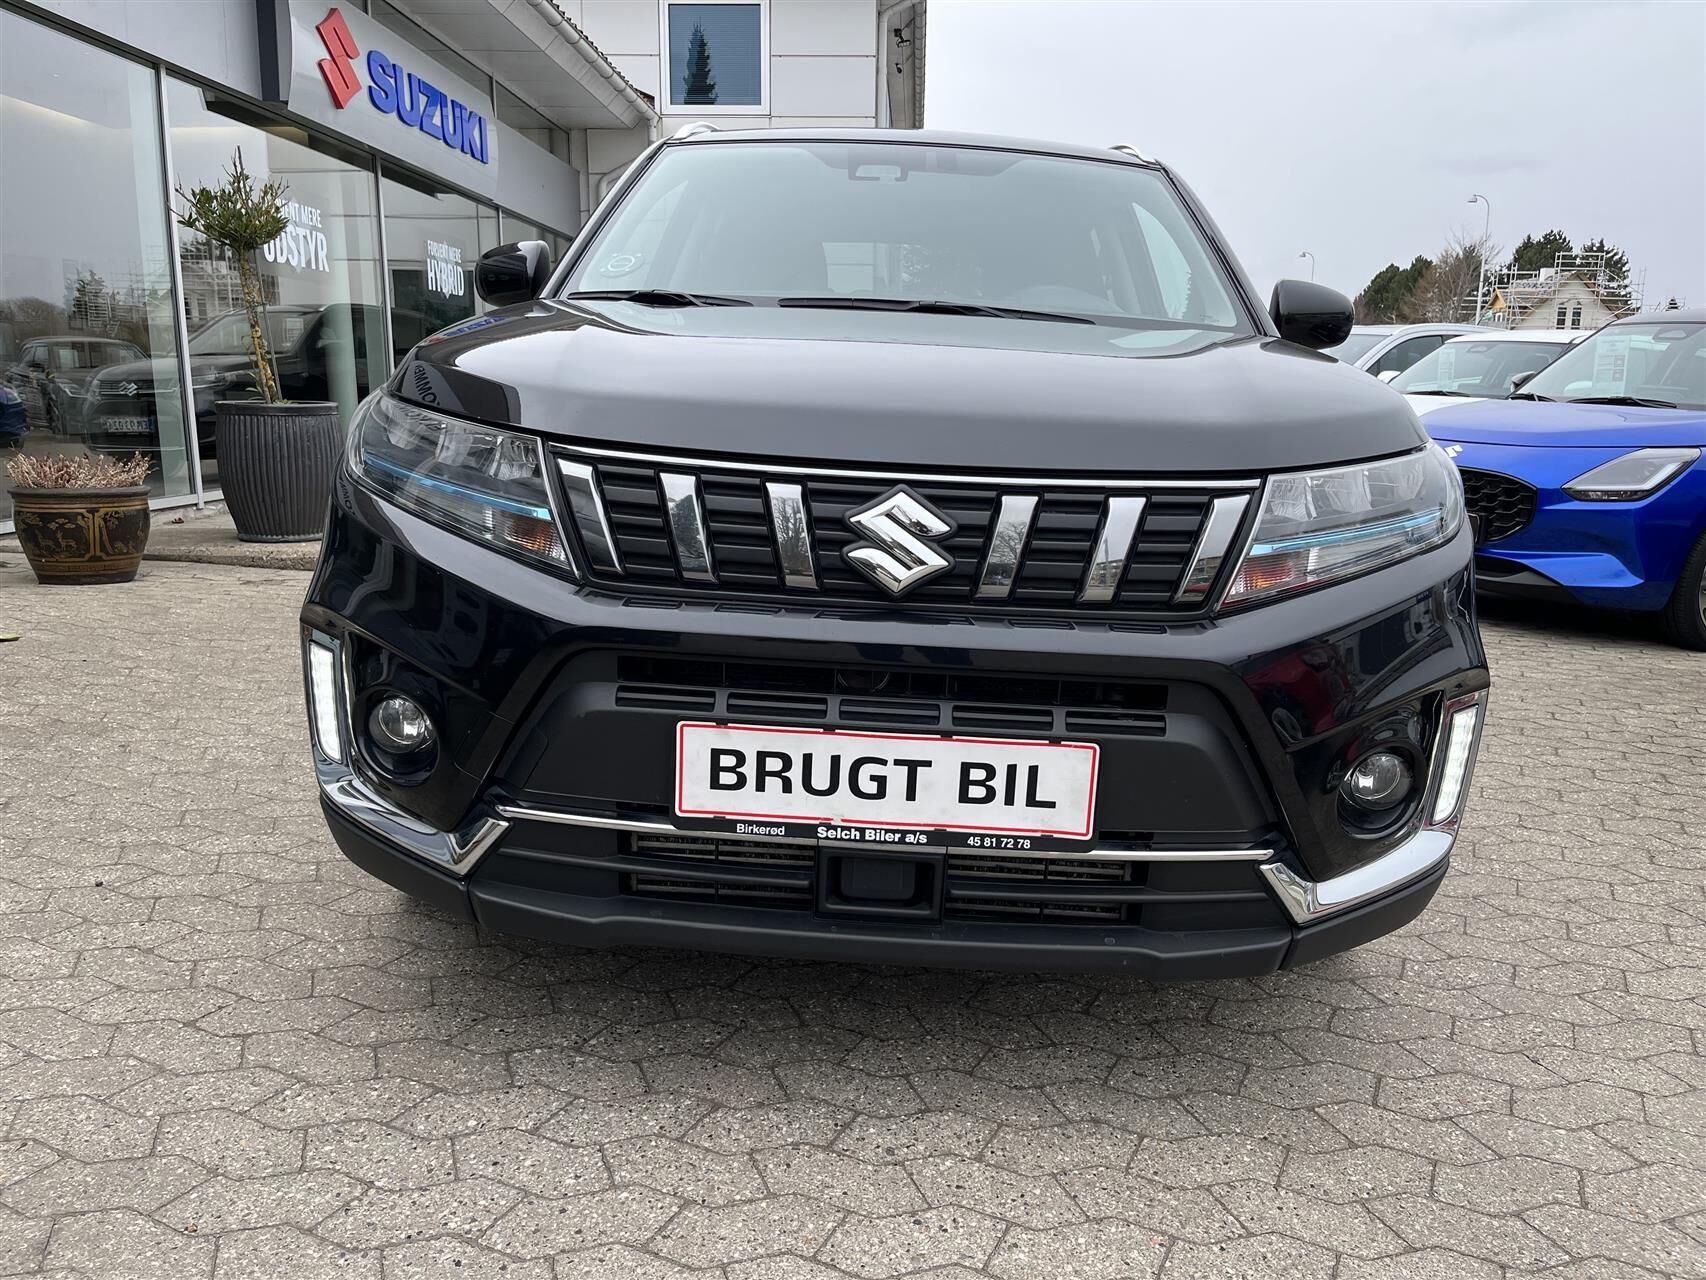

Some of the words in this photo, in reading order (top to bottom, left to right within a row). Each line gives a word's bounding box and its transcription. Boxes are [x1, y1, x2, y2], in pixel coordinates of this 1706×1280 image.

[367, 50, 488, 164] SUZUKI
[300, 204, 322, 228] MERE
[426, 258, 465, 296] HYBRID
[710, 748, 933, 802] BRUGT
[958, 761, 1057, 809] BIL
[736, 823, 786, 836] Birkerød
[816, 826, 860, 840] Selch
[864, 829, 902, 843] Biler
[905, 831, 928, 844] a/s
[967, 836, 981, 846] 45
[984, 837, 997, 847] 81
[1001, 838, 1014, 848] 72
[1017, 839, 1031, 849] 78
